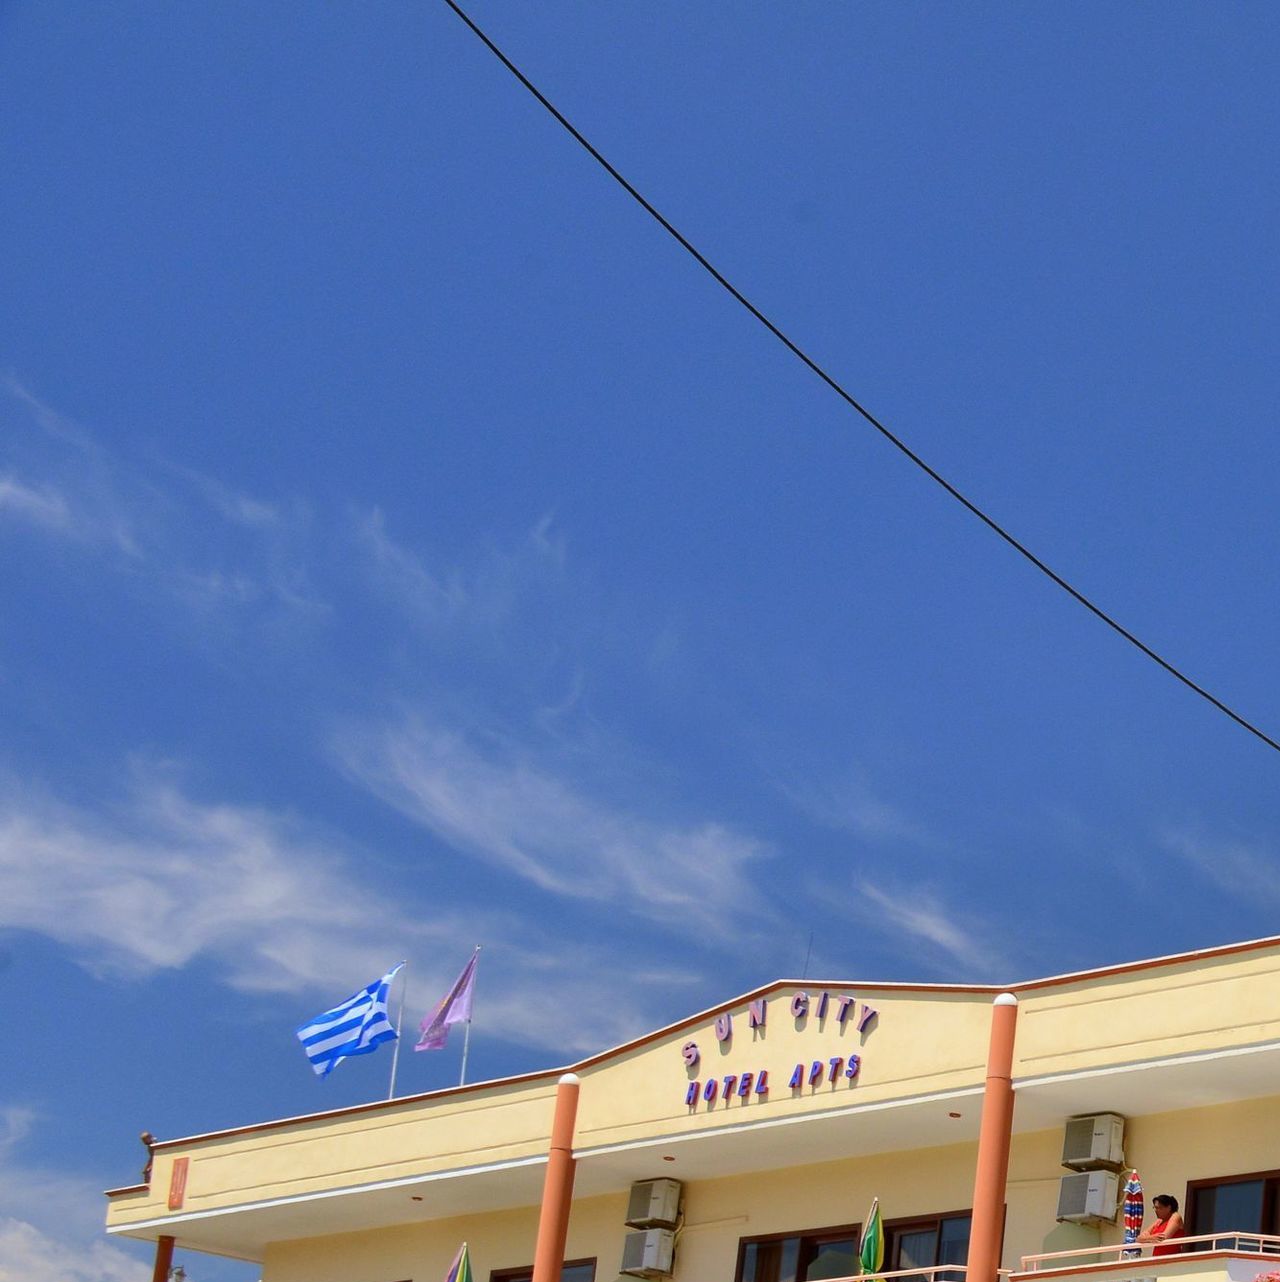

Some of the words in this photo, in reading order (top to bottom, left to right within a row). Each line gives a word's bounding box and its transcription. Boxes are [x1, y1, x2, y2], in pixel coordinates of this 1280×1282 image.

[682, 999, 767, 1066] SUN
[791, 990, 879, 1033] CITY
[685, 1070, 769, 1105] HOTEL
[789, 1055, 860, 1088] APTS
